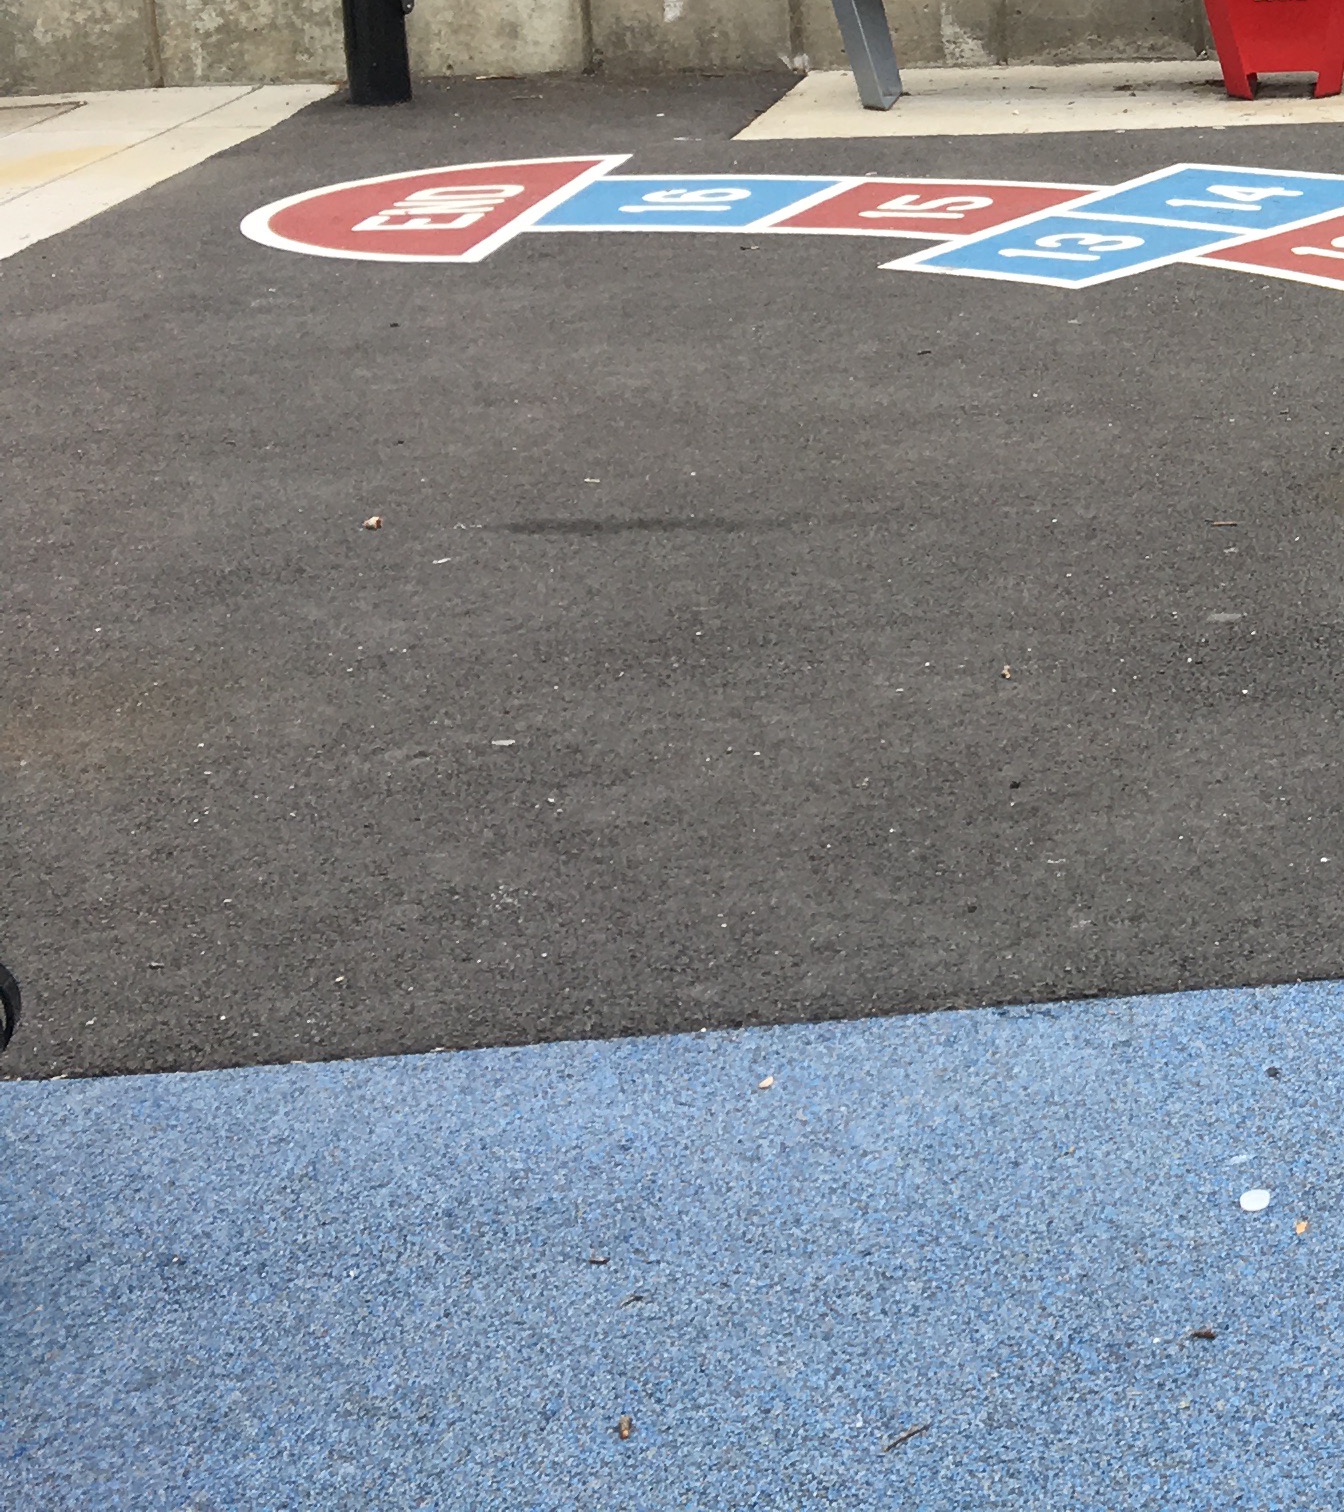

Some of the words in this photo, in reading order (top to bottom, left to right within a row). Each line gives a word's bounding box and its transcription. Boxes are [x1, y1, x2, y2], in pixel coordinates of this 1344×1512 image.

[351, 184, 525, 231] END
[618, 187, 752, 213] 16
[858, 194, 994, 219] 15
[1165, 184, 1303, 212] 14
[998, 232, 1145, 262] 13
